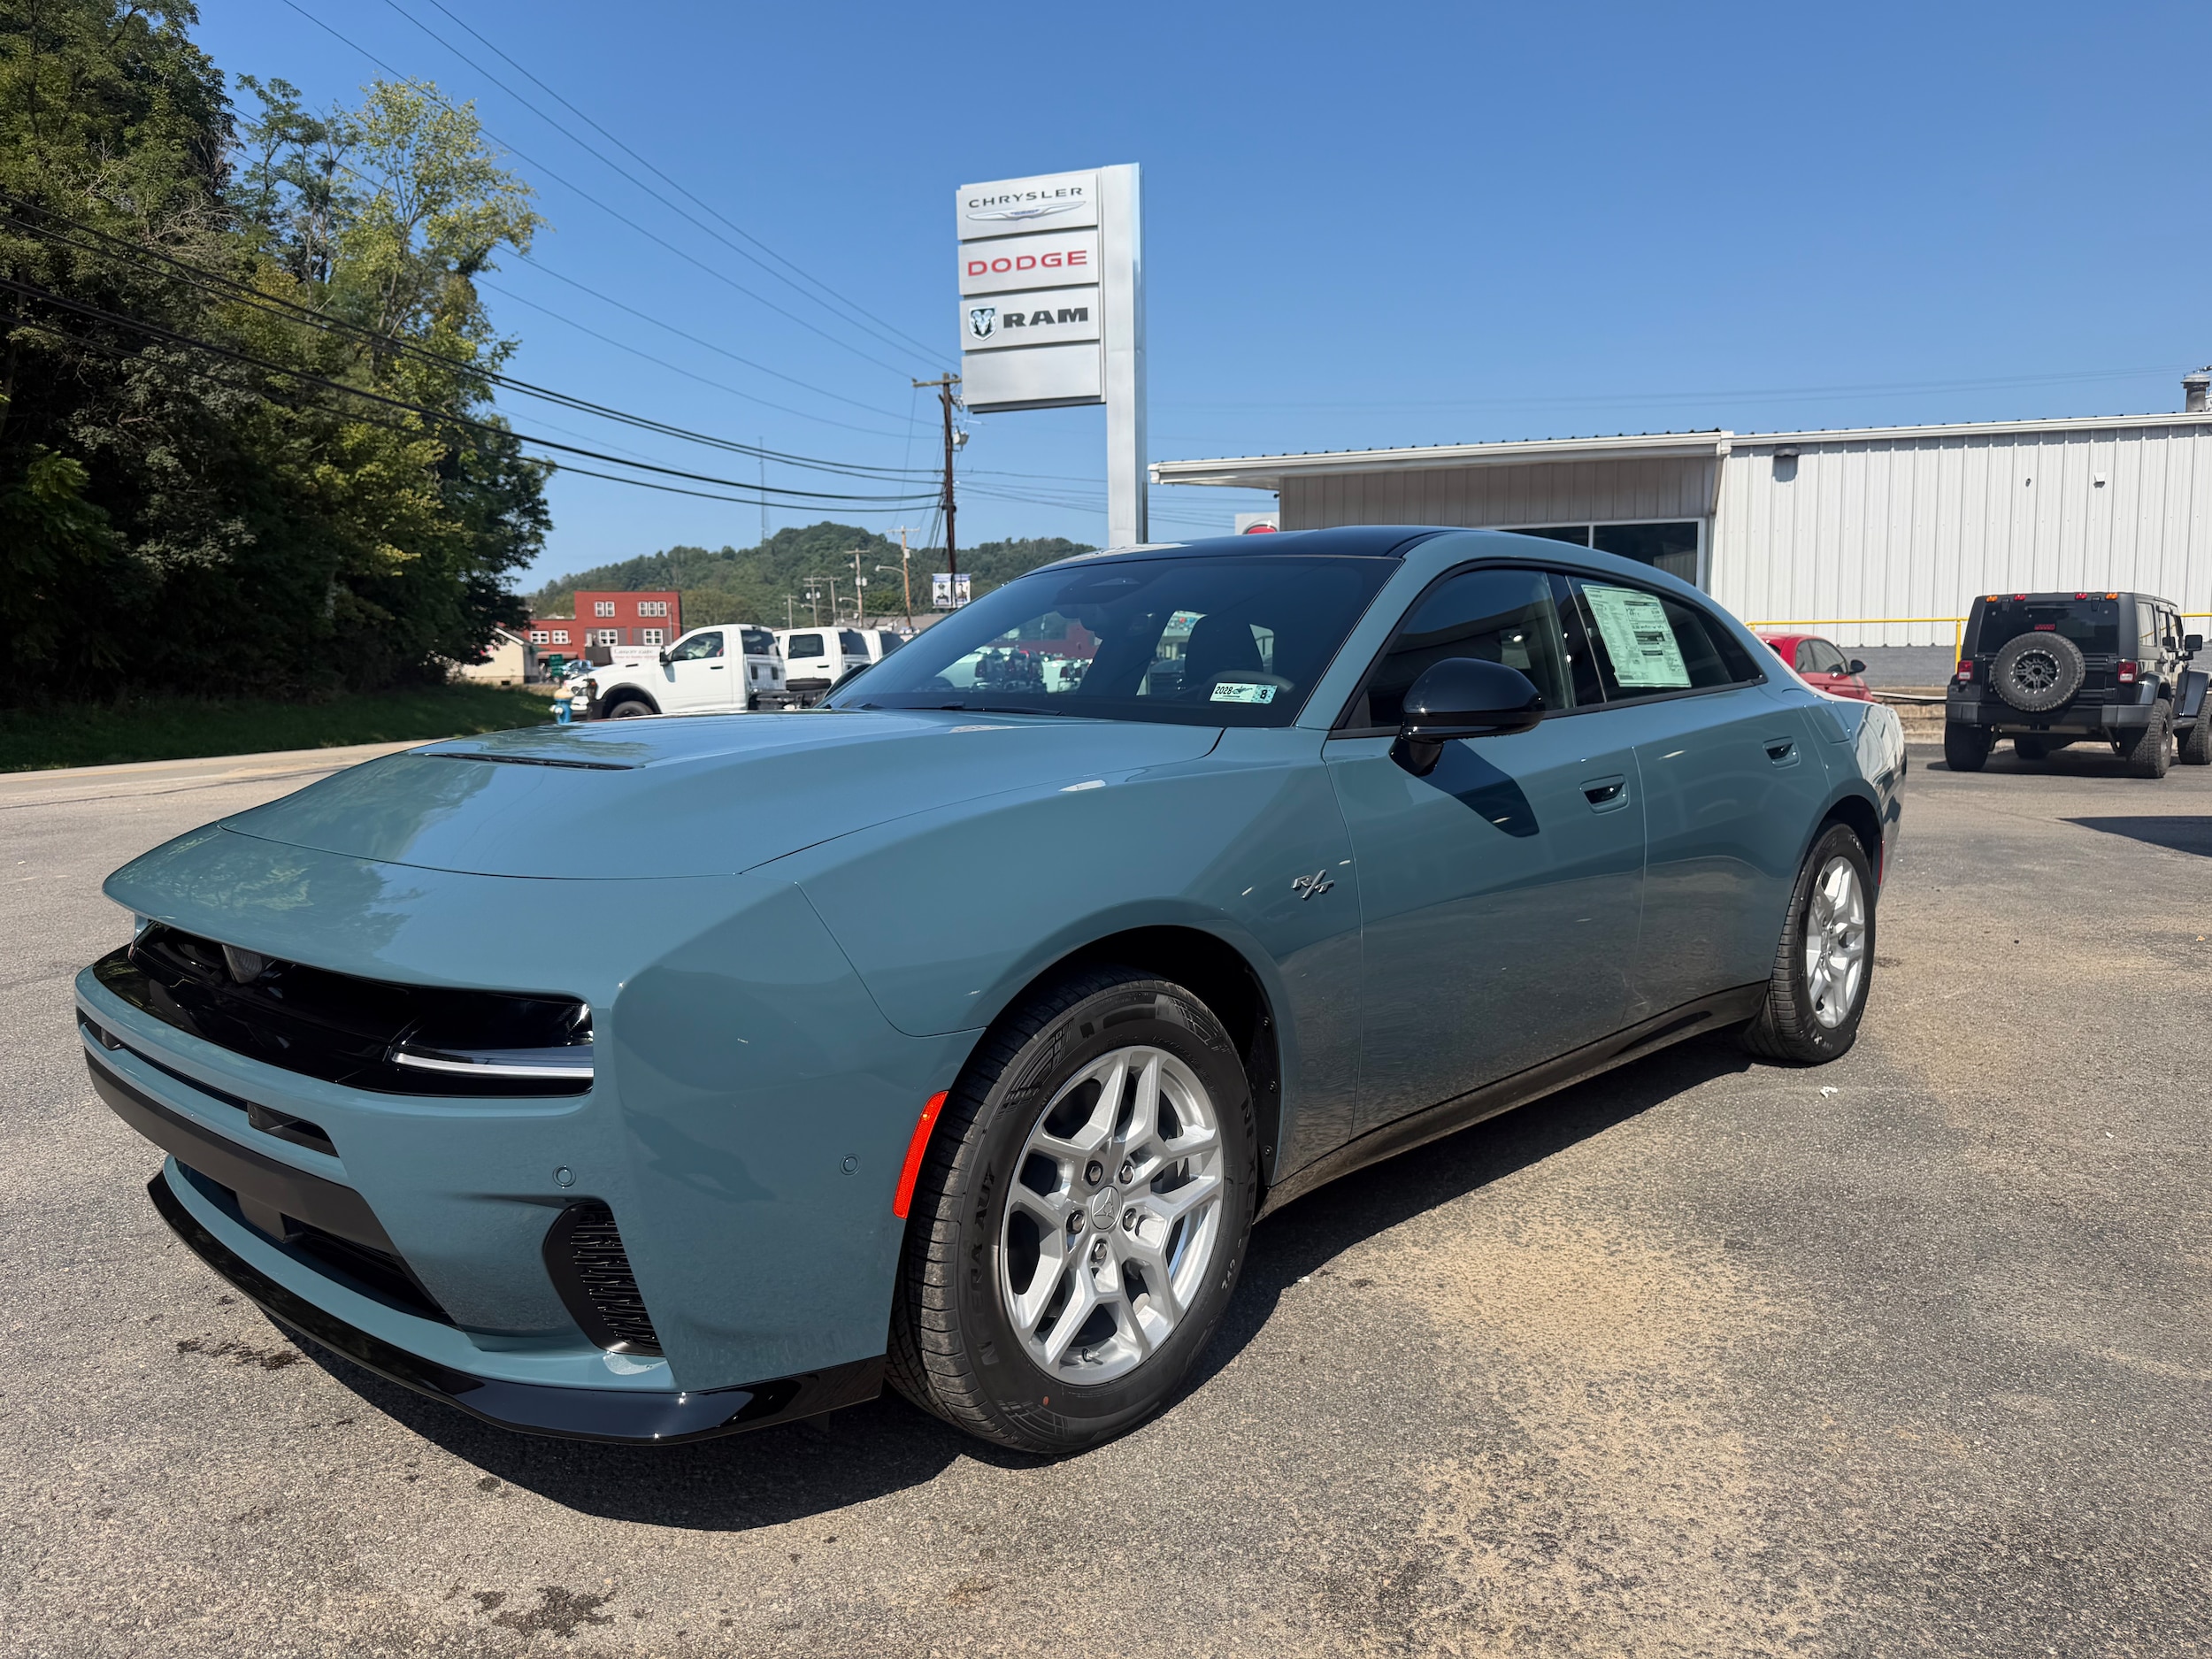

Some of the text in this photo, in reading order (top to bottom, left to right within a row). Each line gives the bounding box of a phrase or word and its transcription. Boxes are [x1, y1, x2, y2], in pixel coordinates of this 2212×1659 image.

[969, 187, 1083, 208] CHRYSLER
[968, 250, 1087, 277] DODGE
[1003, 307, 1088, 329] RAM
[1214, 686, 1268, 700] 2028 8
[1292, 869, 1334, 899] R/T
